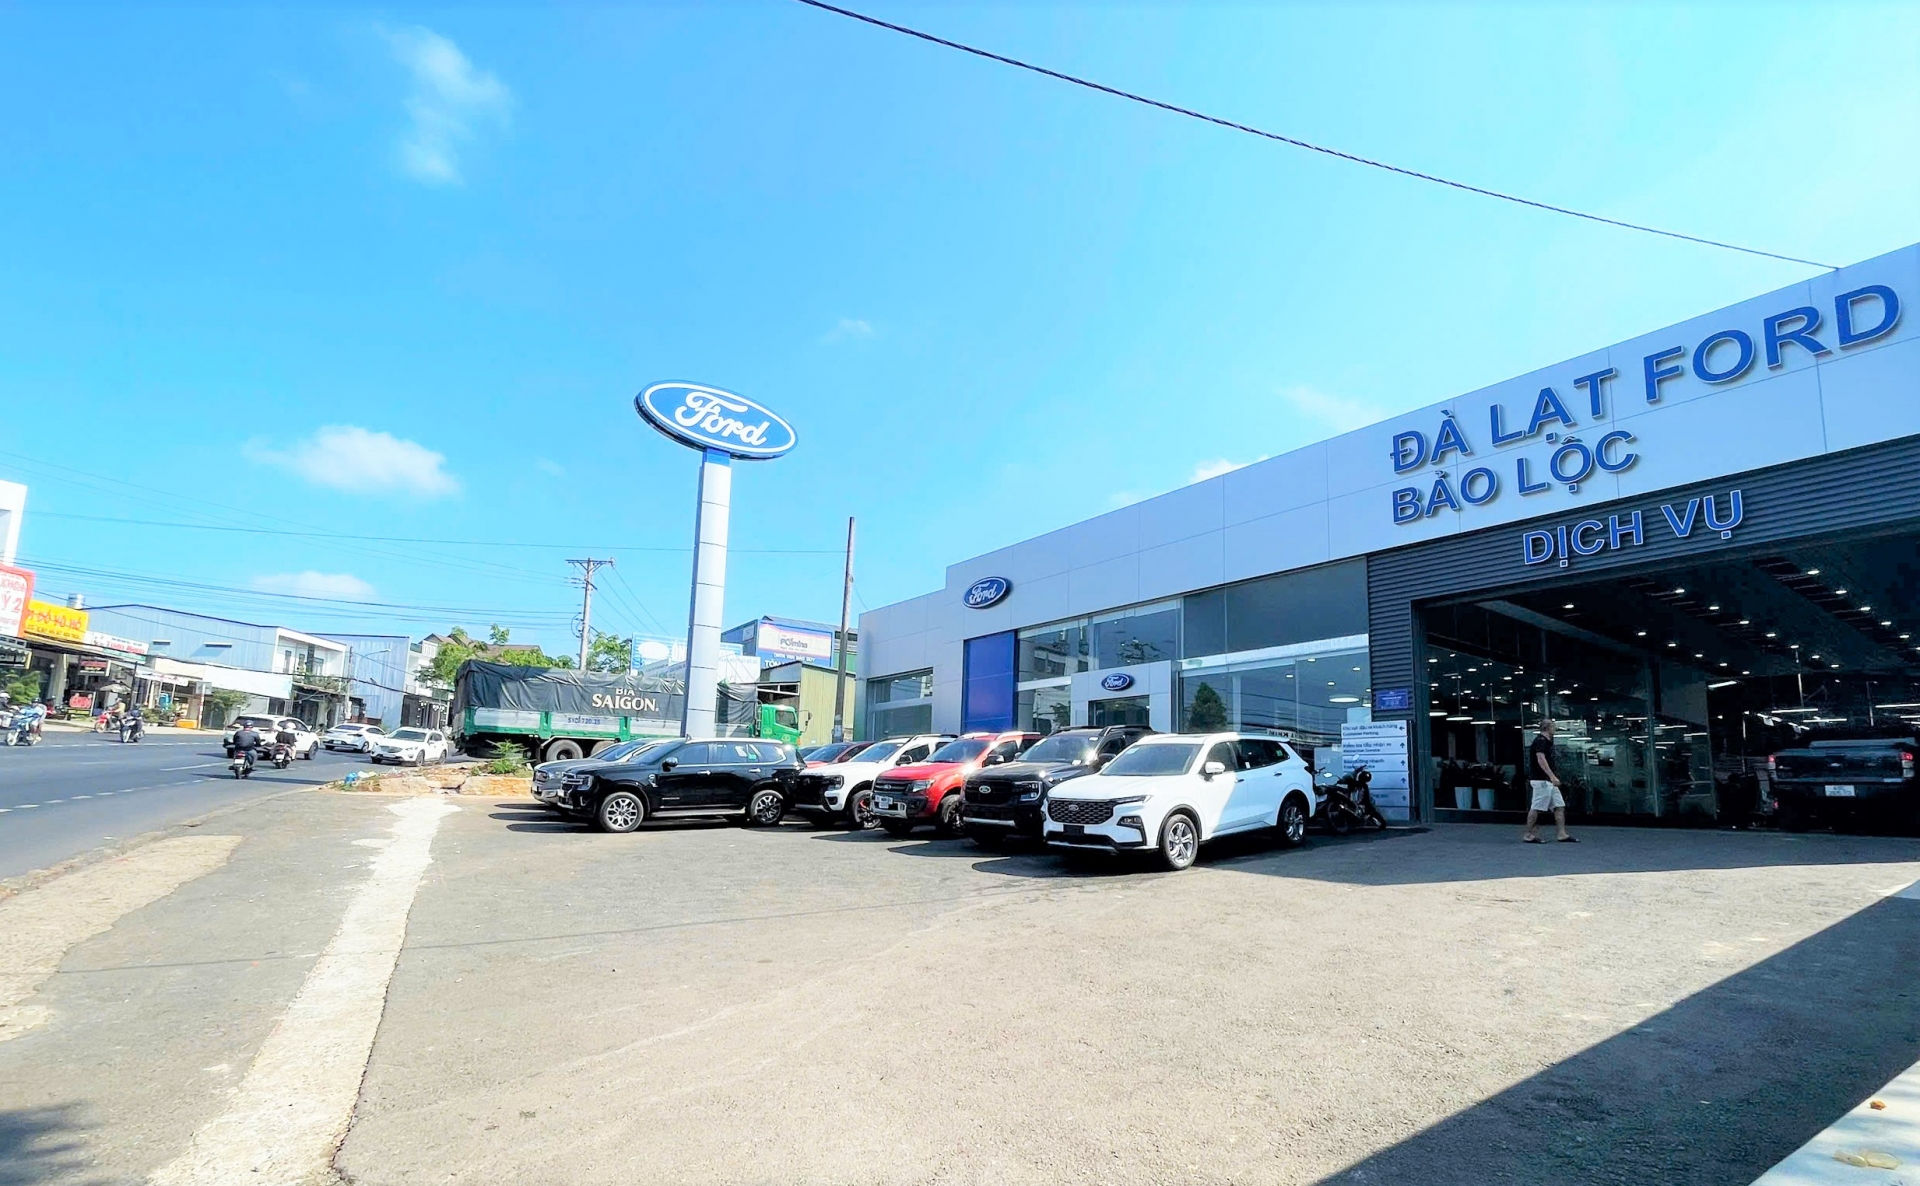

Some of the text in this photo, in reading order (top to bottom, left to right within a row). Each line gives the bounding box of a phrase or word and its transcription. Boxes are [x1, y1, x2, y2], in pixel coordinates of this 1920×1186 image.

[1390, 284, 1902, 475] ĐÀ LẠT FORD
[674, 391, 771, 446] Ford
[1391, 430, 1638, 525] BẢO LỘC
[1523, 489, 1745, 568] DỊCH VỤ
[968, 580, 999, 604] Ford
[1103, 675, 1125, 689] Ford
